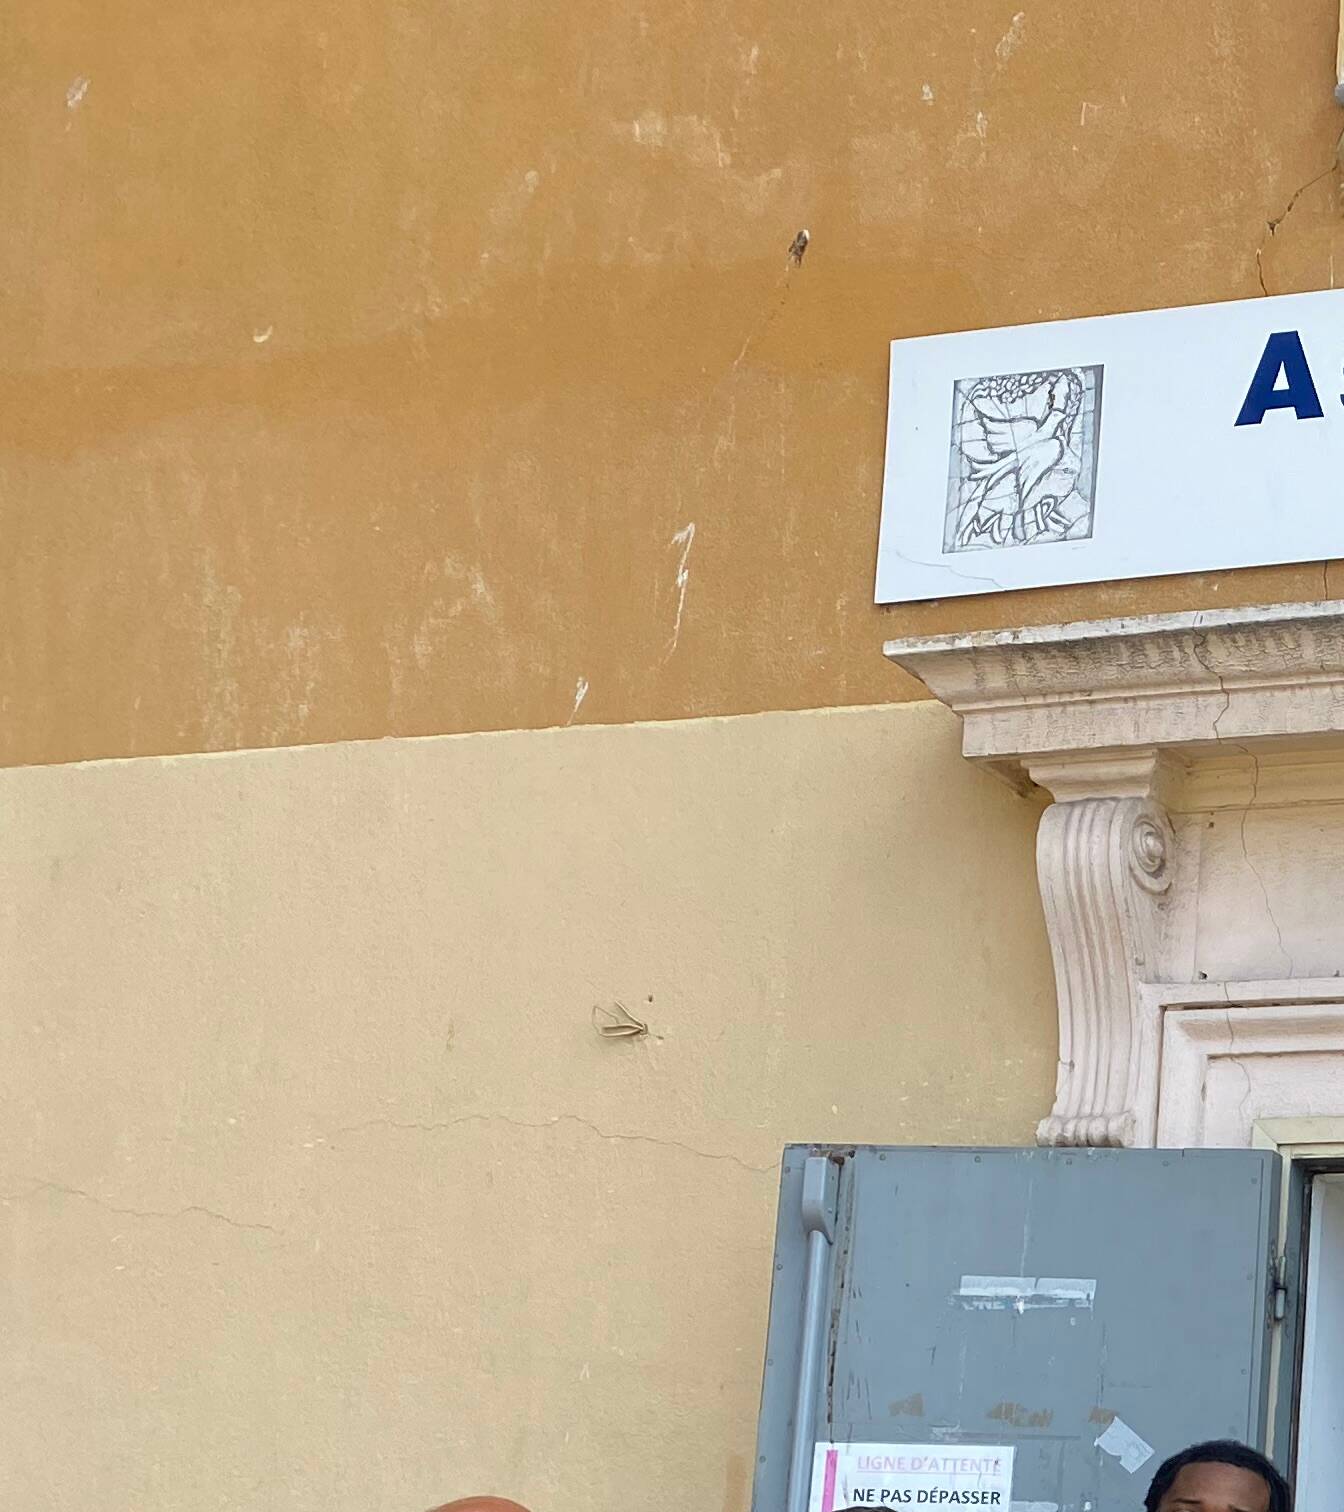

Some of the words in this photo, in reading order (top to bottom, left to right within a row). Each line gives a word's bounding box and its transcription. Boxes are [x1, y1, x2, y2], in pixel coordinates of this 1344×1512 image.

[857, 1456, 906, 1472] LIGNE
[911, 1457, 1001, 1474] D'ATTENTE
[853, 1488, 875, 1503] NE
[881, 1489, 912, 1504] PAS
[917, 1486, 1001, 1505] DÉPASSER
